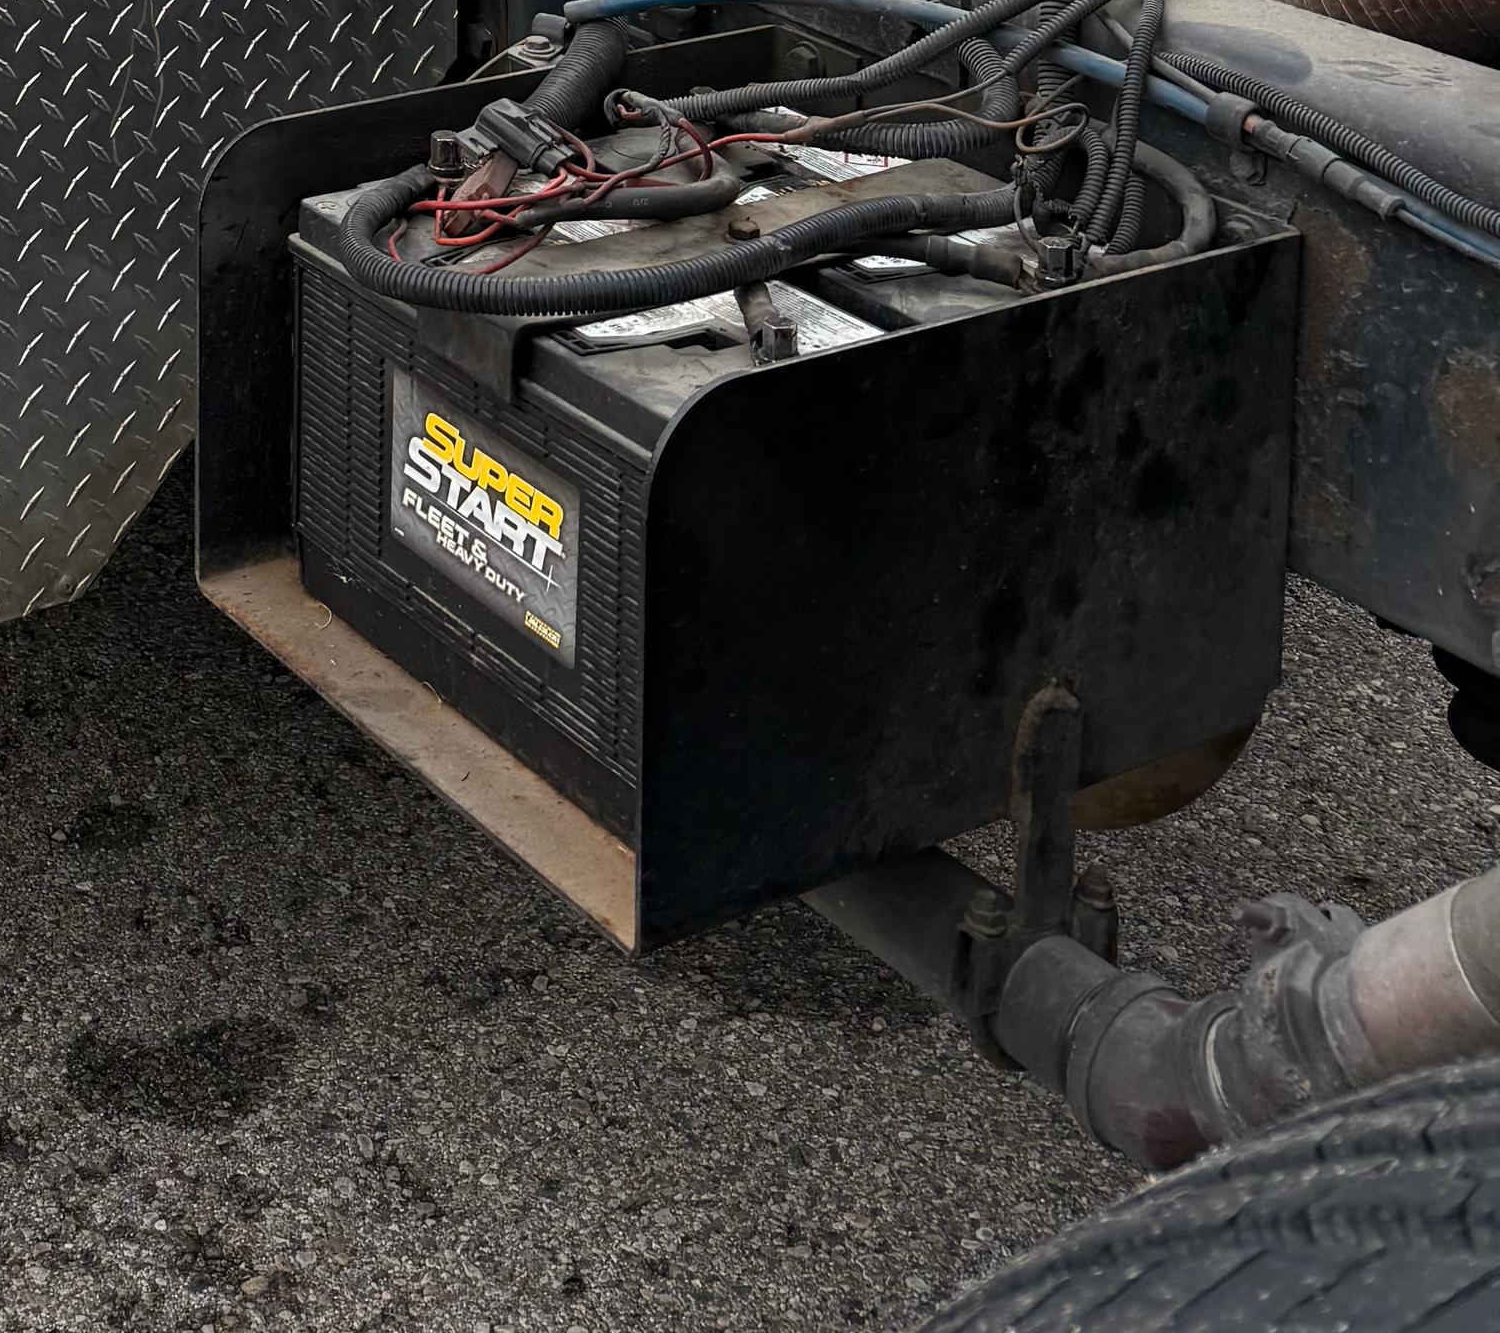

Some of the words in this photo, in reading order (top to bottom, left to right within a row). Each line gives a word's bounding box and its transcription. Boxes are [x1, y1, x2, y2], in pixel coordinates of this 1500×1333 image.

[402, 487, 470, 546] FLEET
[471, 538, 488, 566] &
[404, 436, 564, 571] START
[425, 412, 564, 540] SUPER
[436, 530, 485, 573] HEAVY
[484, 564, 525, 603] DUTY
